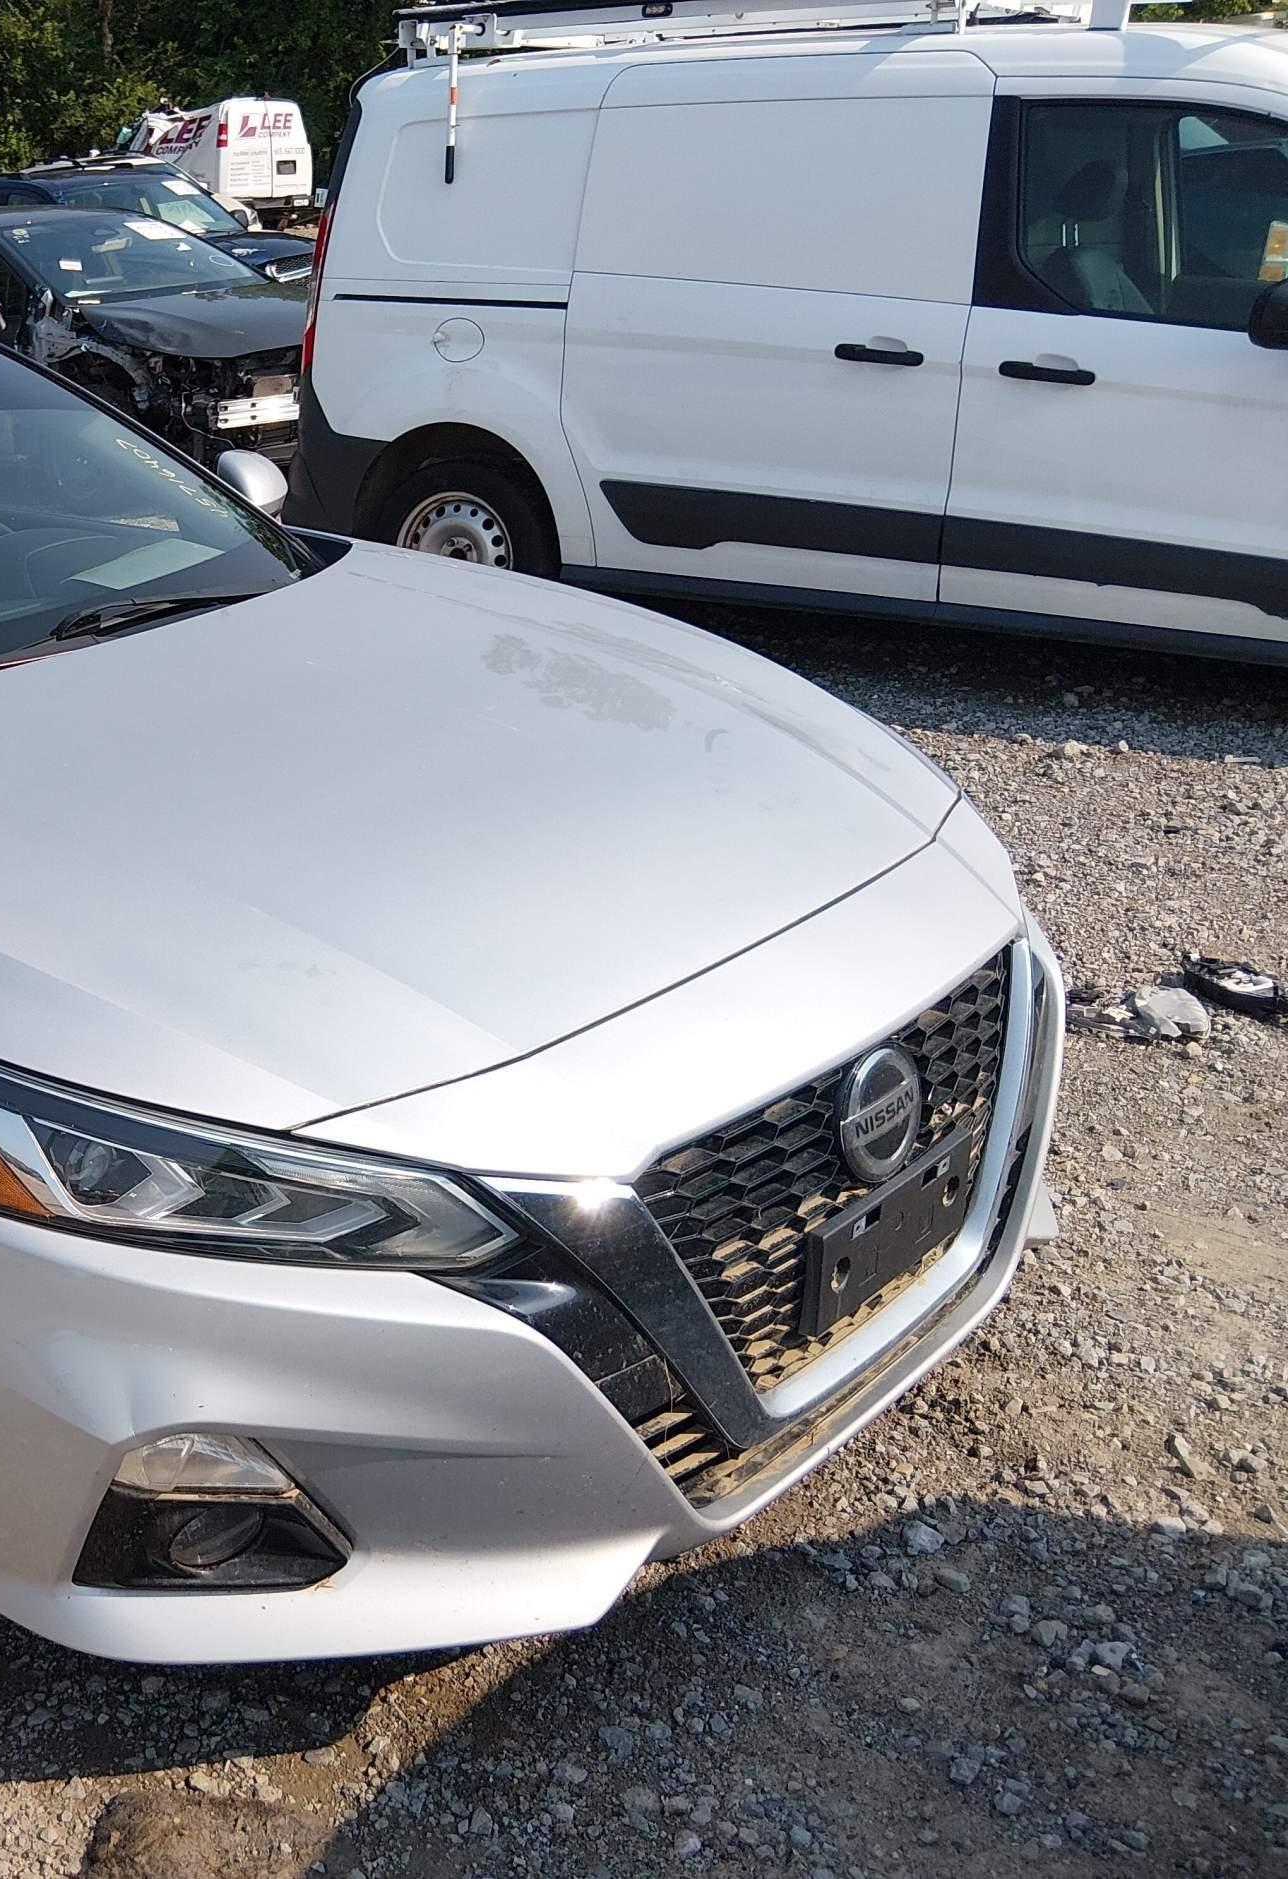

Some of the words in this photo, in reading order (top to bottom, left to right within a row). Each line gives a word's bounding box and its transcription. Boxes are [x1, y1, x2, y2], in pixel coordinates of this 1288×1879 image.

[158, 115, 212, 145] LEE
[260, 113, 293, 130] LEE
[155, 140, 200, 155] COMPNY
[855, 1086, 914, 1138] NISSAN
